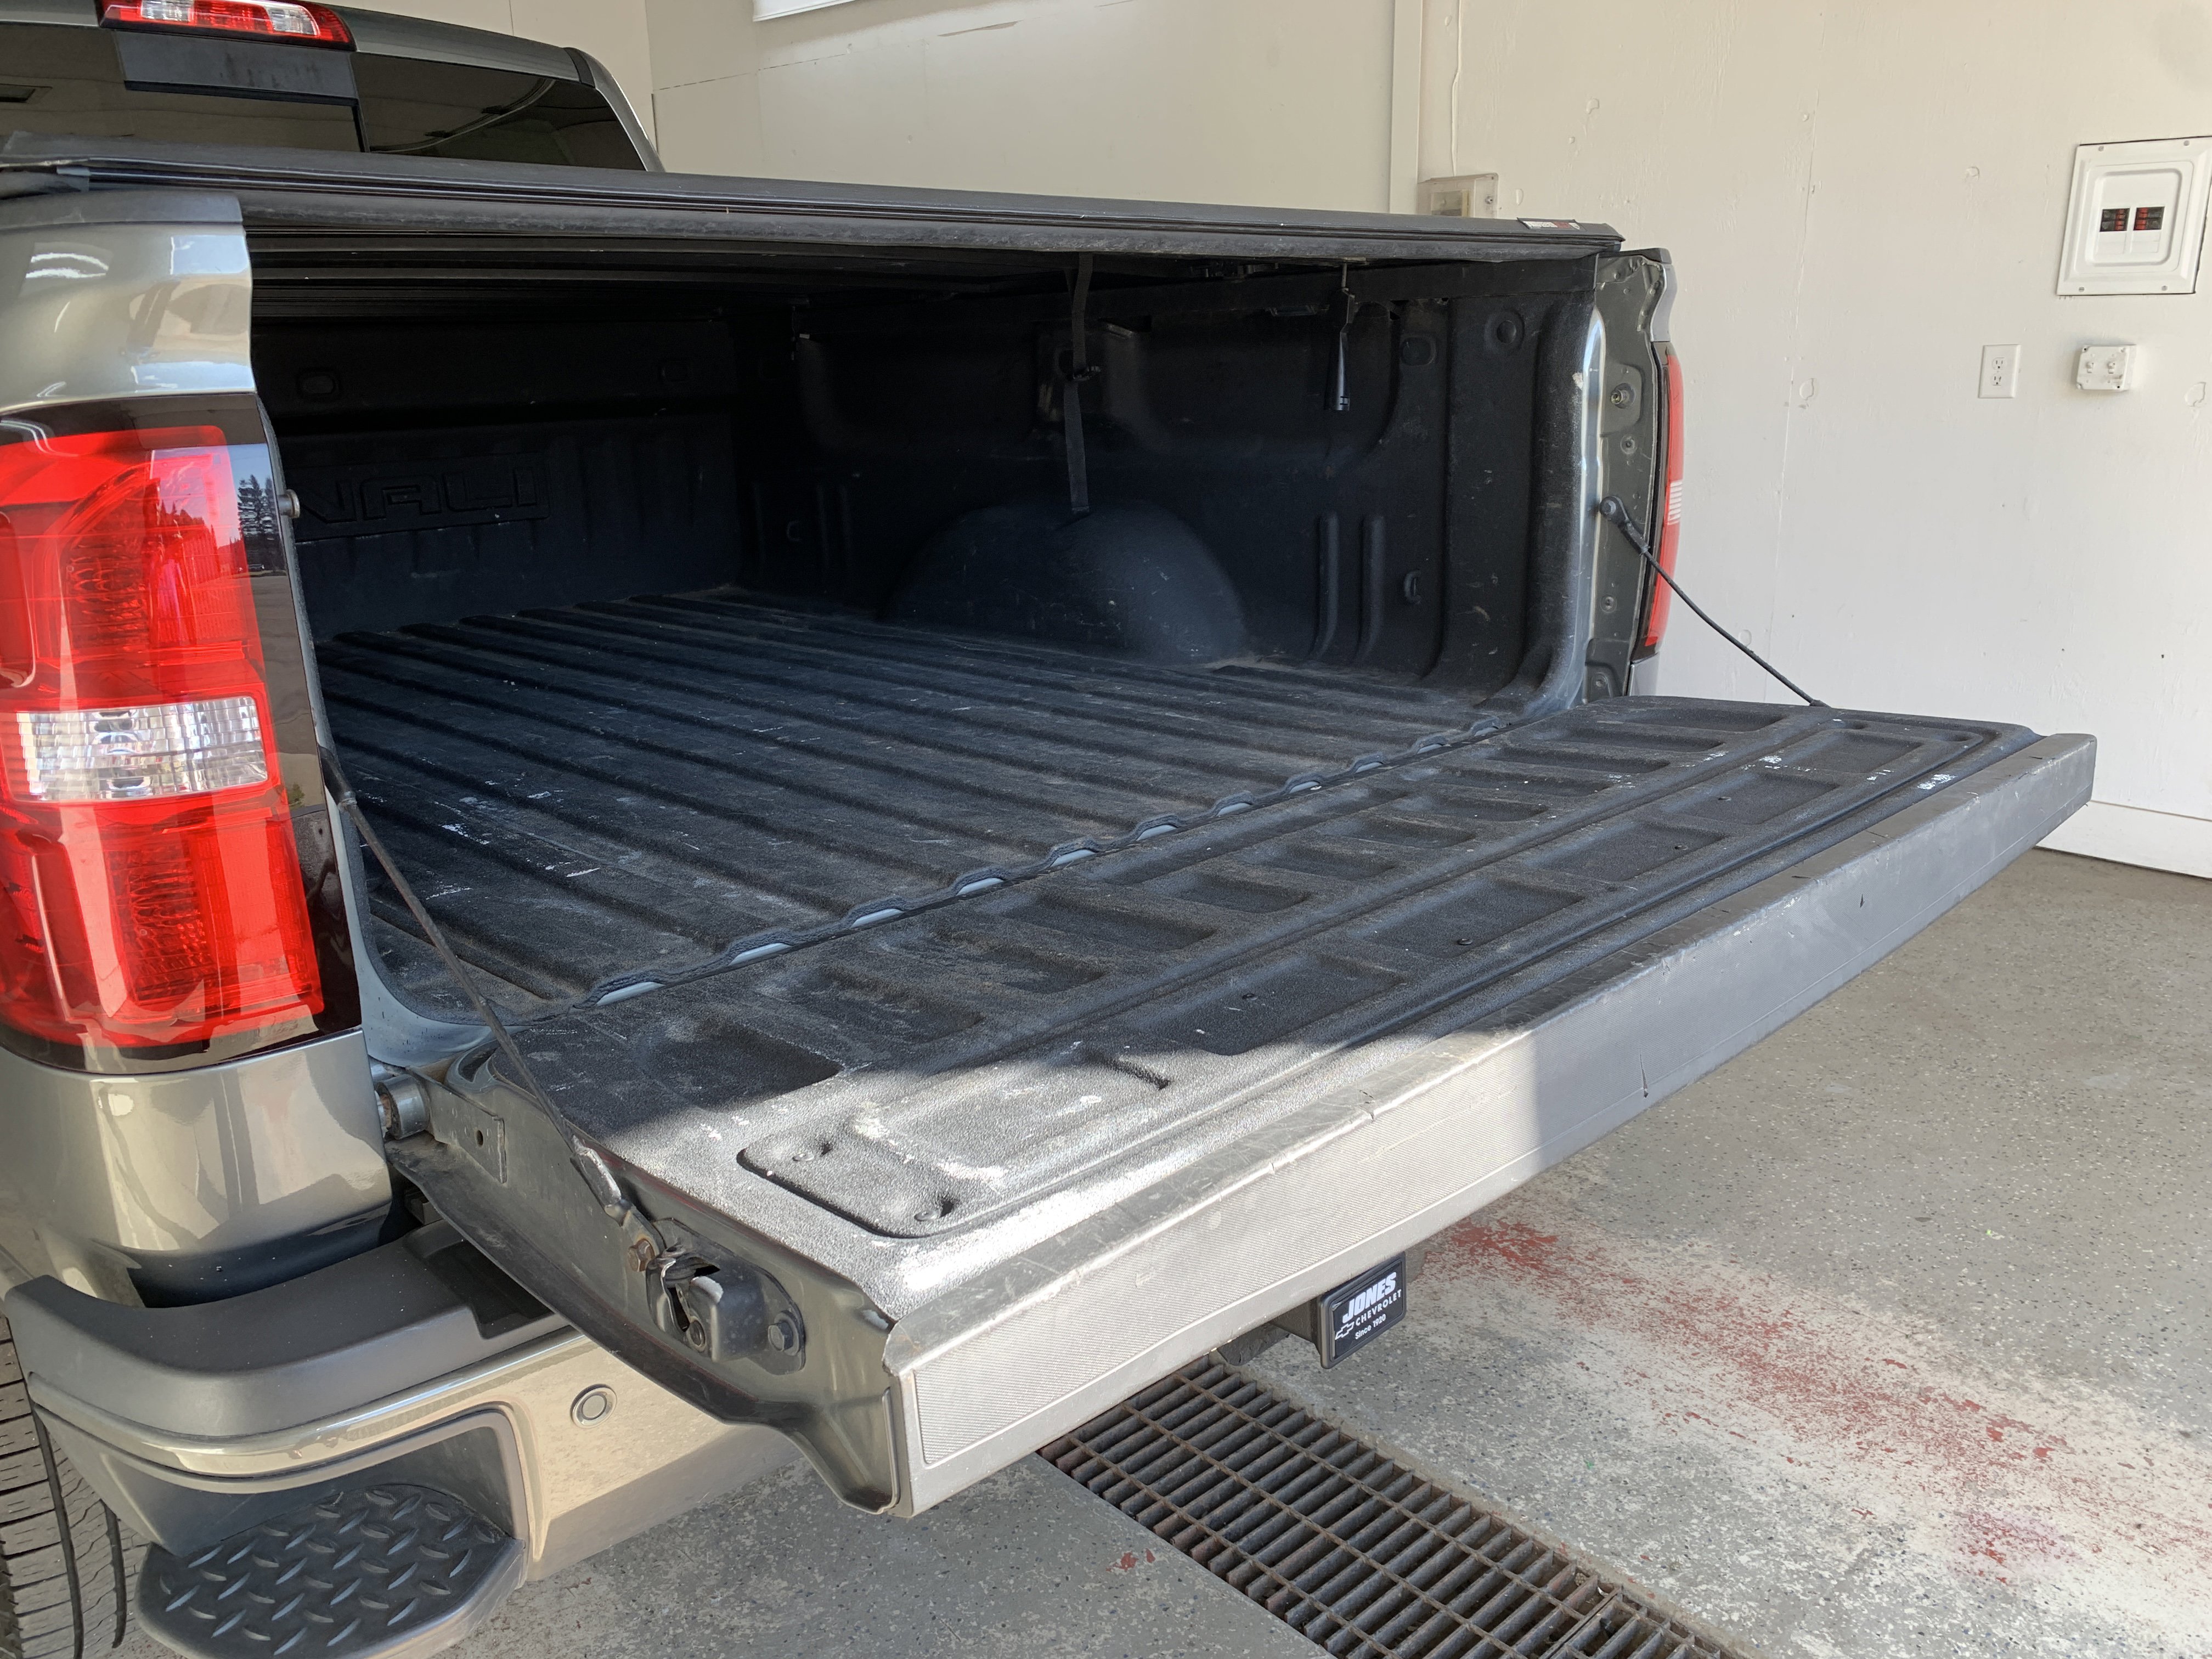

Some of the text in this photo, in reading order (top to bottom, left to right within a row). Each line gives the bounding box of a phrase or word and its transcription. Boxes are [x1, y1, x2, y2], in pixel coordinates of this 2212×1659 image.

[1342, 1272, 1396, 1323] JONES
[1356, 1289, 1401, 1326] CHEVROLET
[1355, 1314, 1386, 1339] Since 1920
